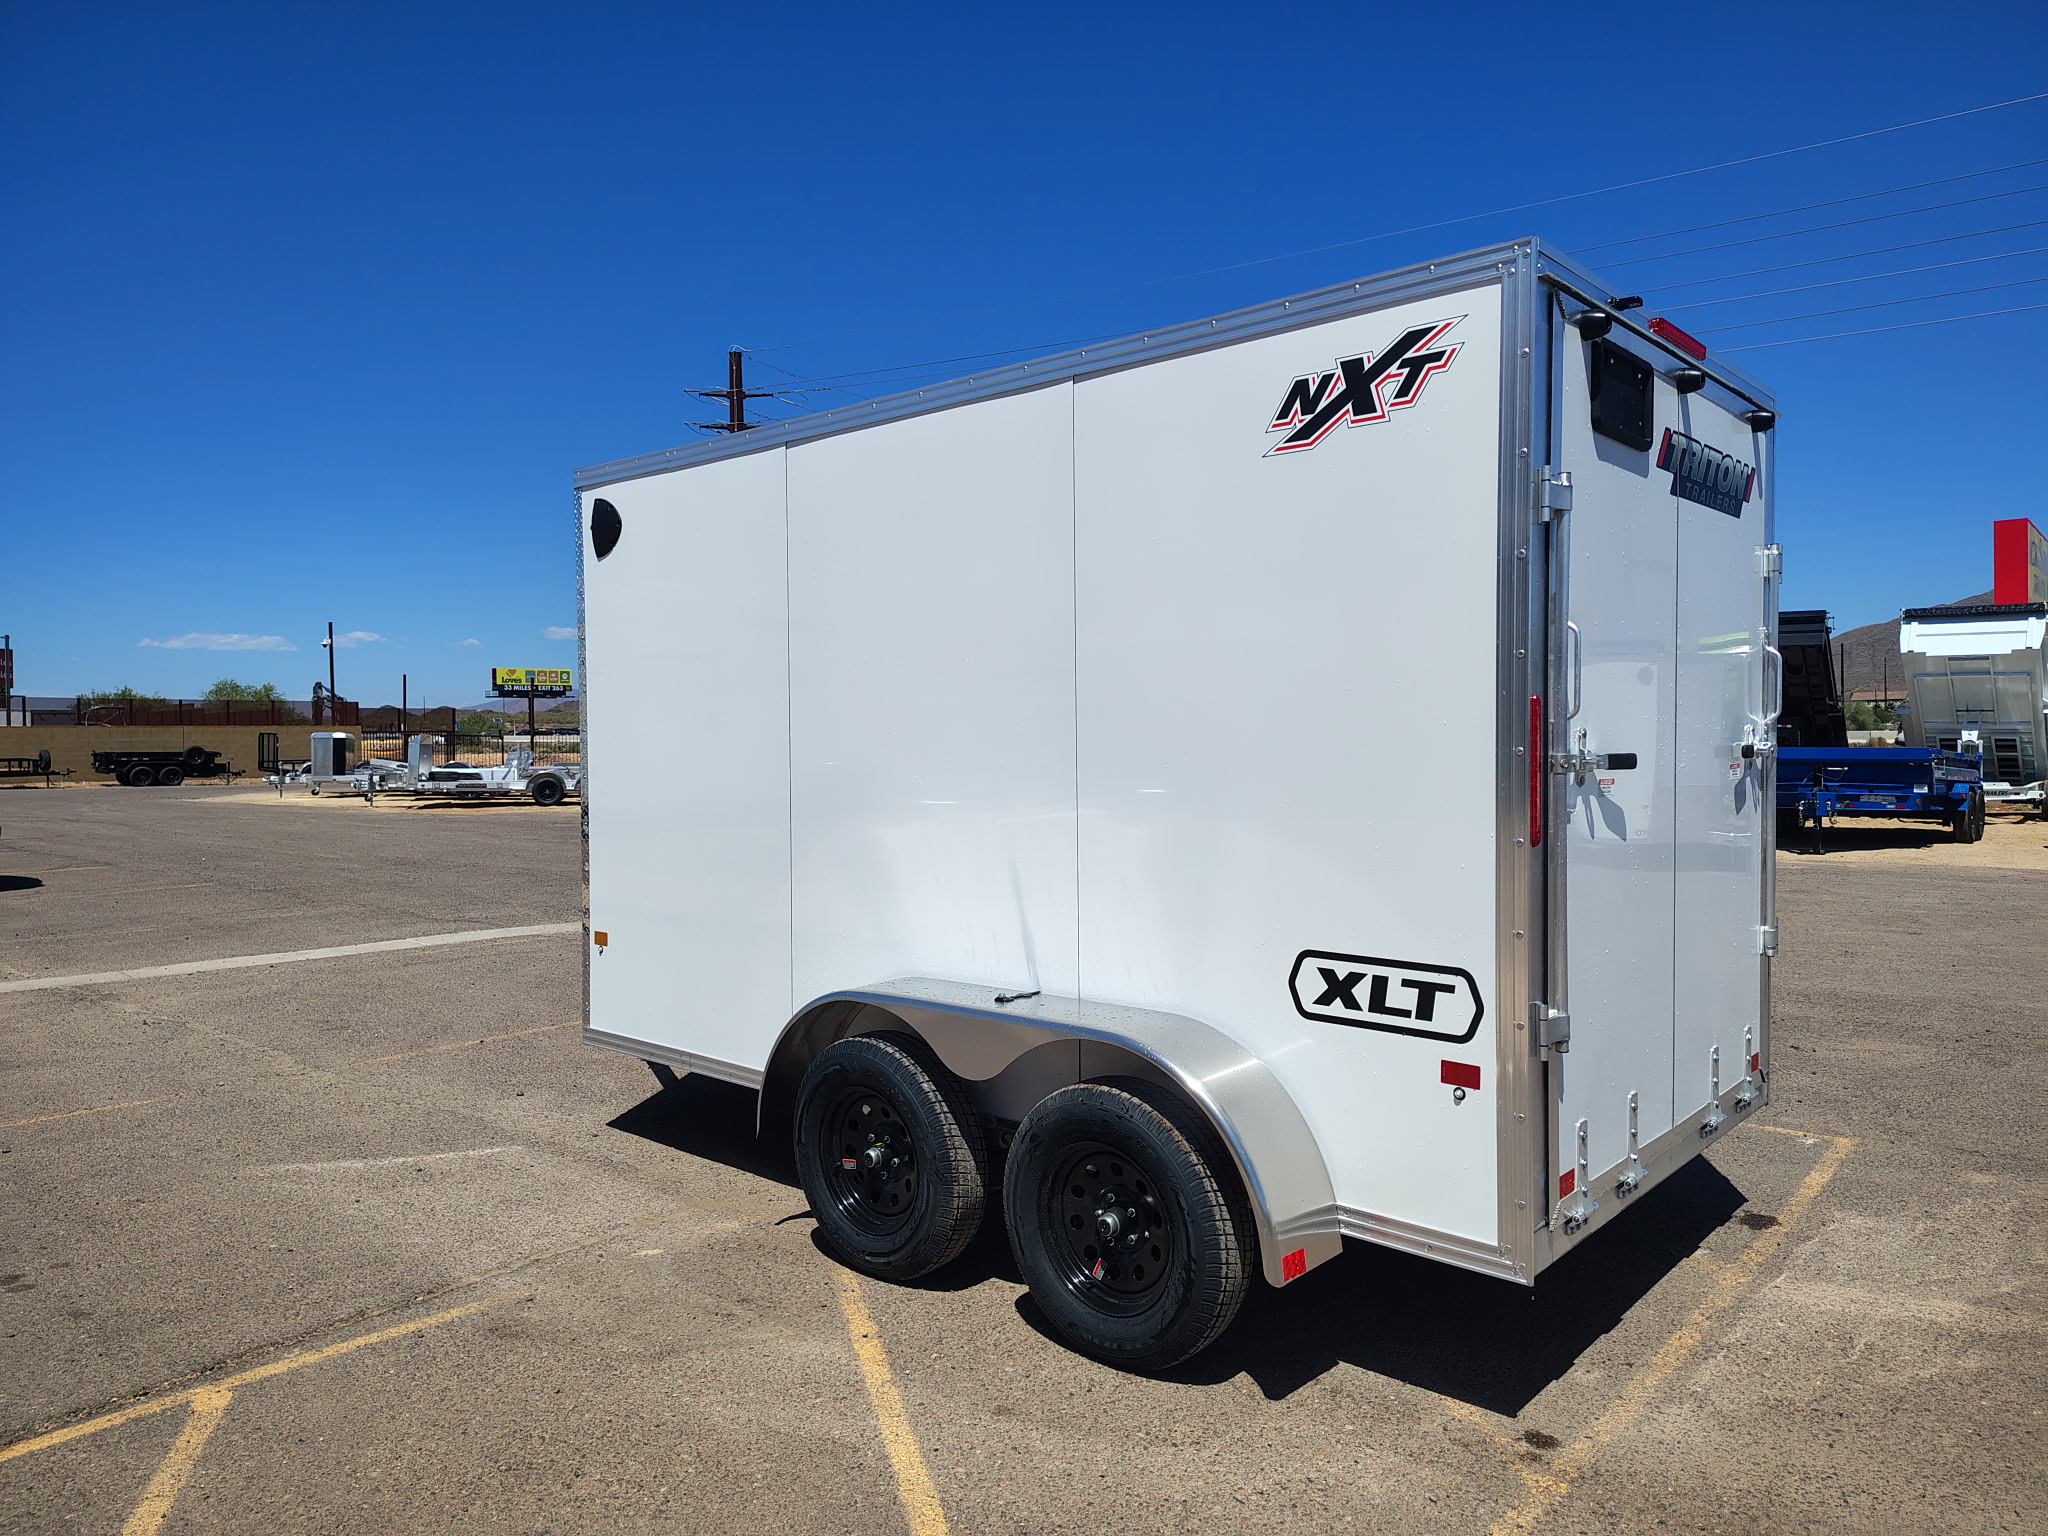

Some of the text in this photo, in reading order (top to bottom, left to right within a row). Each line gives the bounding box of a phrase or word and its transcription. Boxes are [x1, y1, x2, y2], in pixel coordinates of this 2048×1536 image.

[1270, 318, 1462, 454] NXT
[1669, 431, 1750, 500] TRITON
[1685, 482, 1736, 514] TRAILERS
[1311, 966, 1456, 1022] XLT
